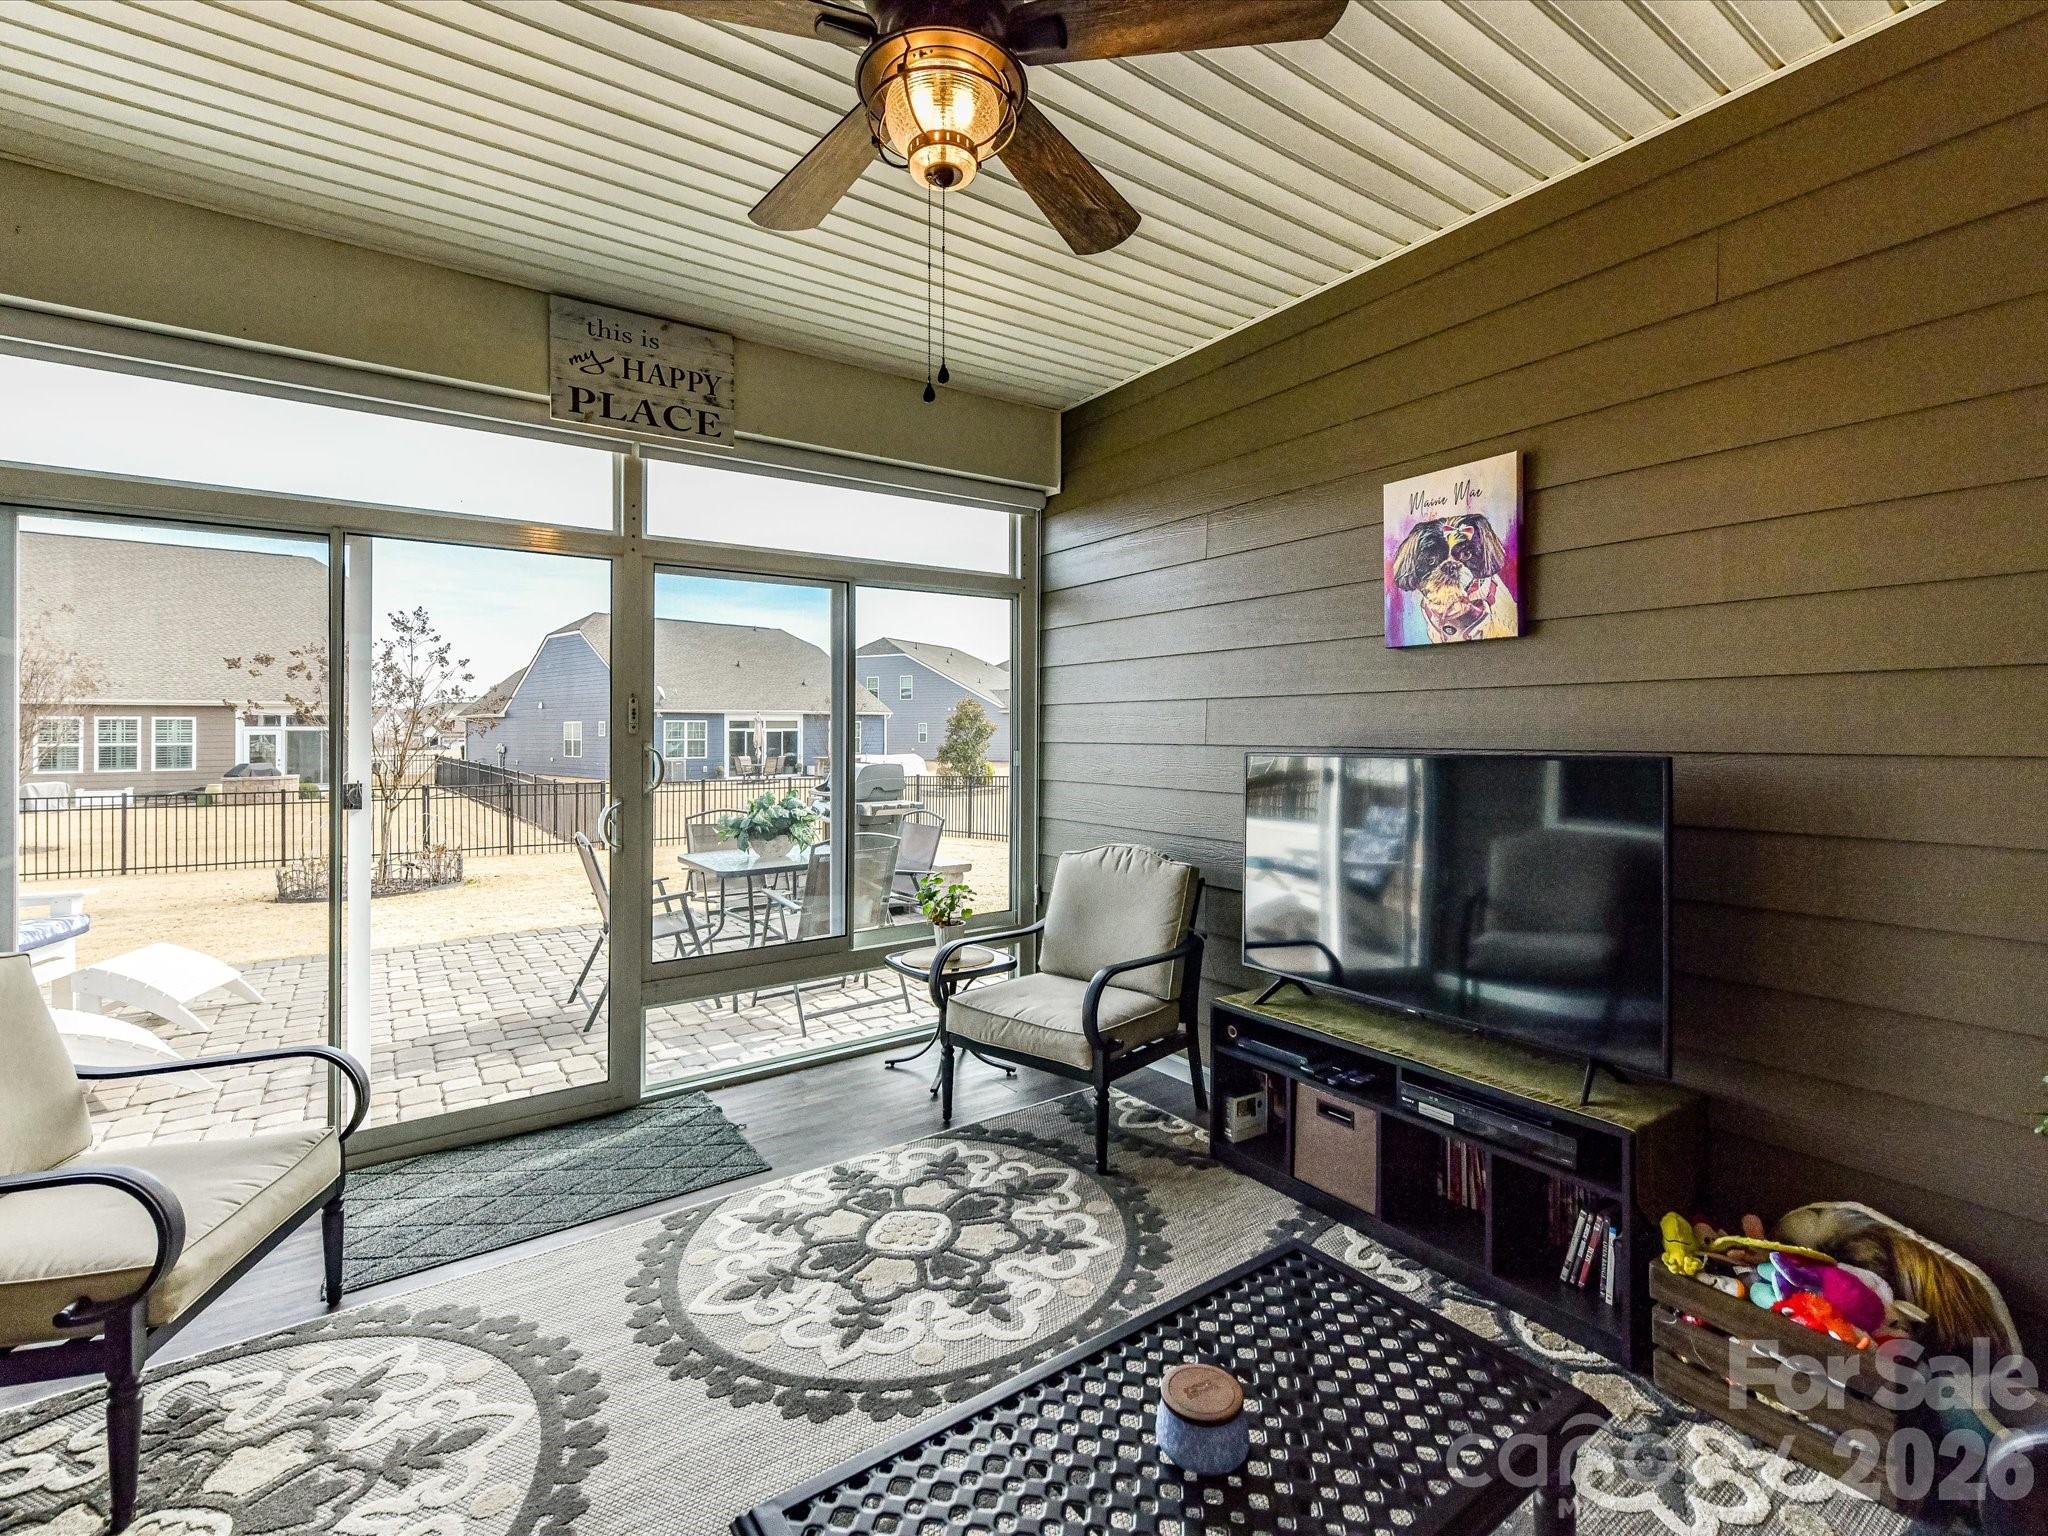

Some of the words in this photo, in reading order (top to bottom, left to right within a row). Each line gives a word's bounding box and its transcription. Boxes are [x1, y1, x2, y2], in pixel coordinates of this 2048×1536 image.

[586, 318, 633, 344] this
[640, 329, 660, 350] is
[568, 350, 615, 375] my
[621, 356, 723, 396] HAPPY
[567, 385, 722, 438] PLACE
[1409, 490, 1448, 516] Maisie
[1453, 479, 1482, 506] Mae
